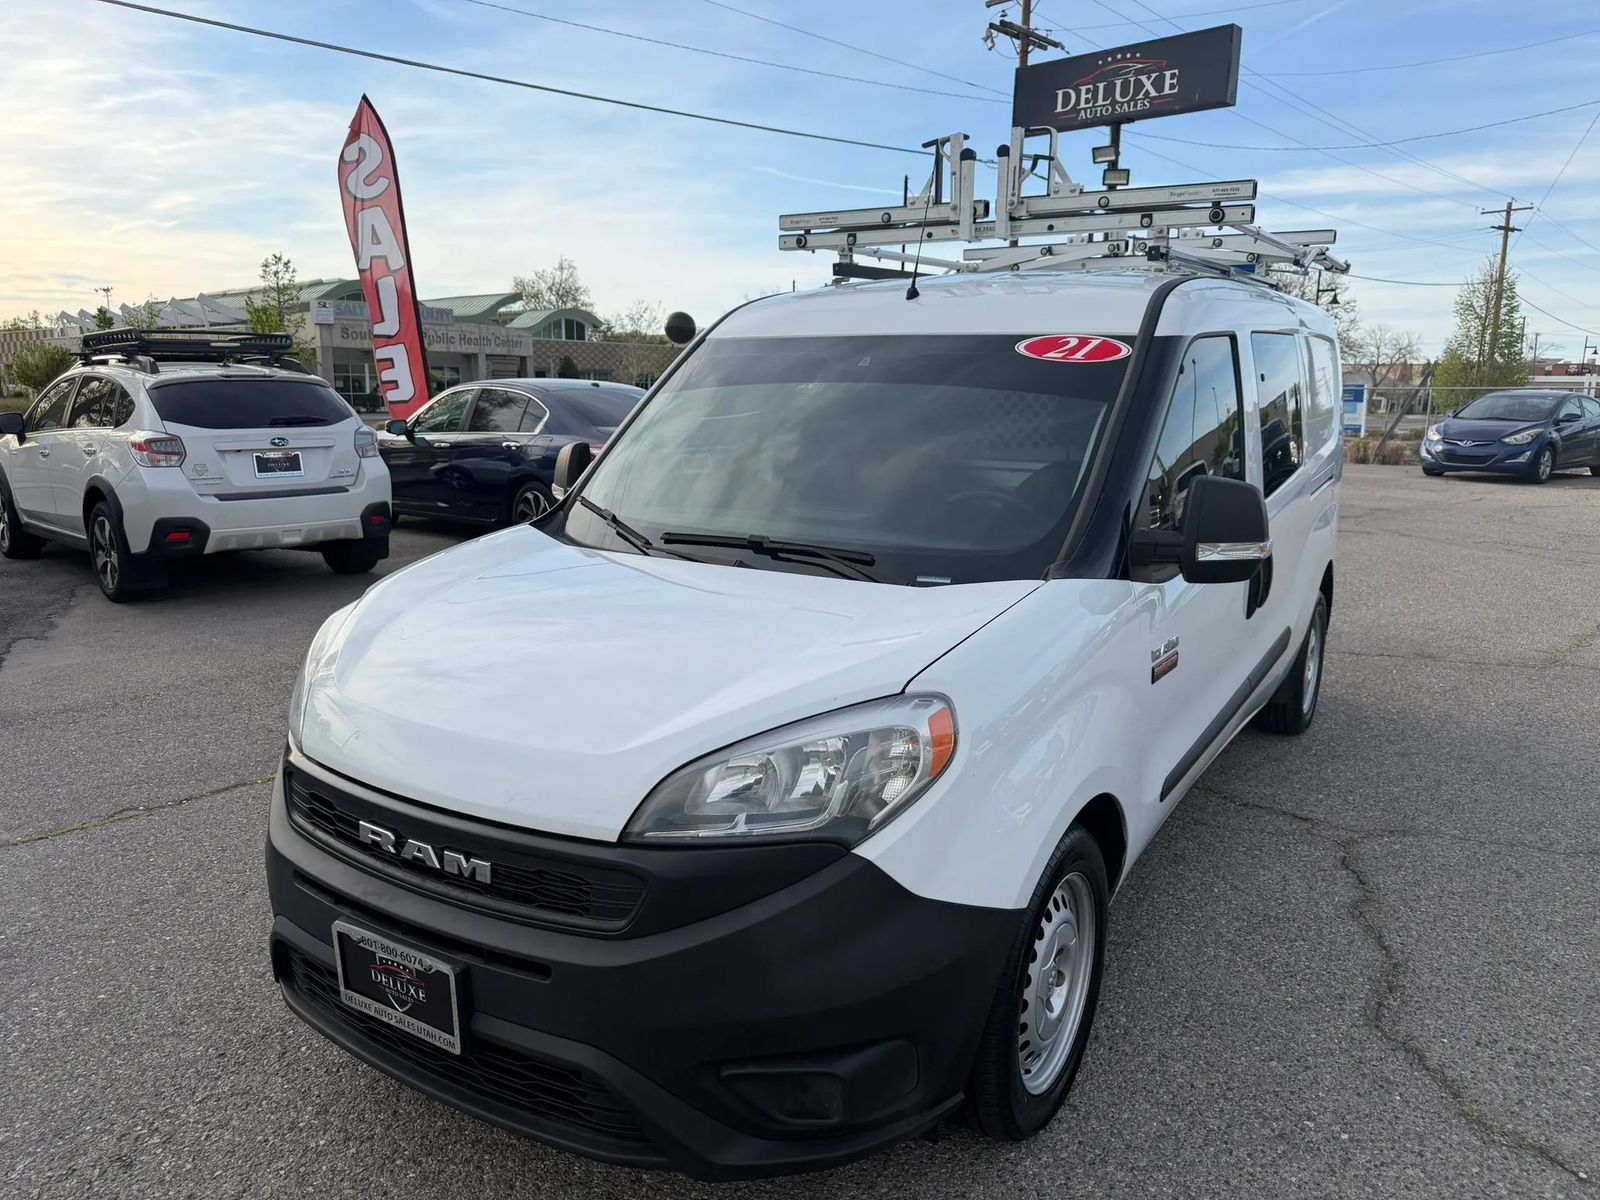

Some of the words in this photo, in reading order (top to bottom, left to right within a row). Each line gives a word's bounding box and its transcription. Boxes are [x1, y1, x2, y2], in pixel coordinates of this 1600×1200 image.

[1054, 69, 1179, 113] DELUXE
[1078, 104, 1111, 120] AUTO
[1114, 99, 1150, 115] SALES
[459, 333, 492, 348] Health
[495, 335, 523, 349] Center
[1041, 337, 1104, 360] 21
[359, 820, 491, 884] RAM
[361, 936, 424, 968] 801-800-6074
[371, 970, 427, 1002] DELUXE
[345, 993, 372, 1011] DELUXE
[374, 1006, 393, 1021] AUTO
[394, 1014, 416, 1031] SALES
[417, 1025, 456, 1050] UTAH.COM
